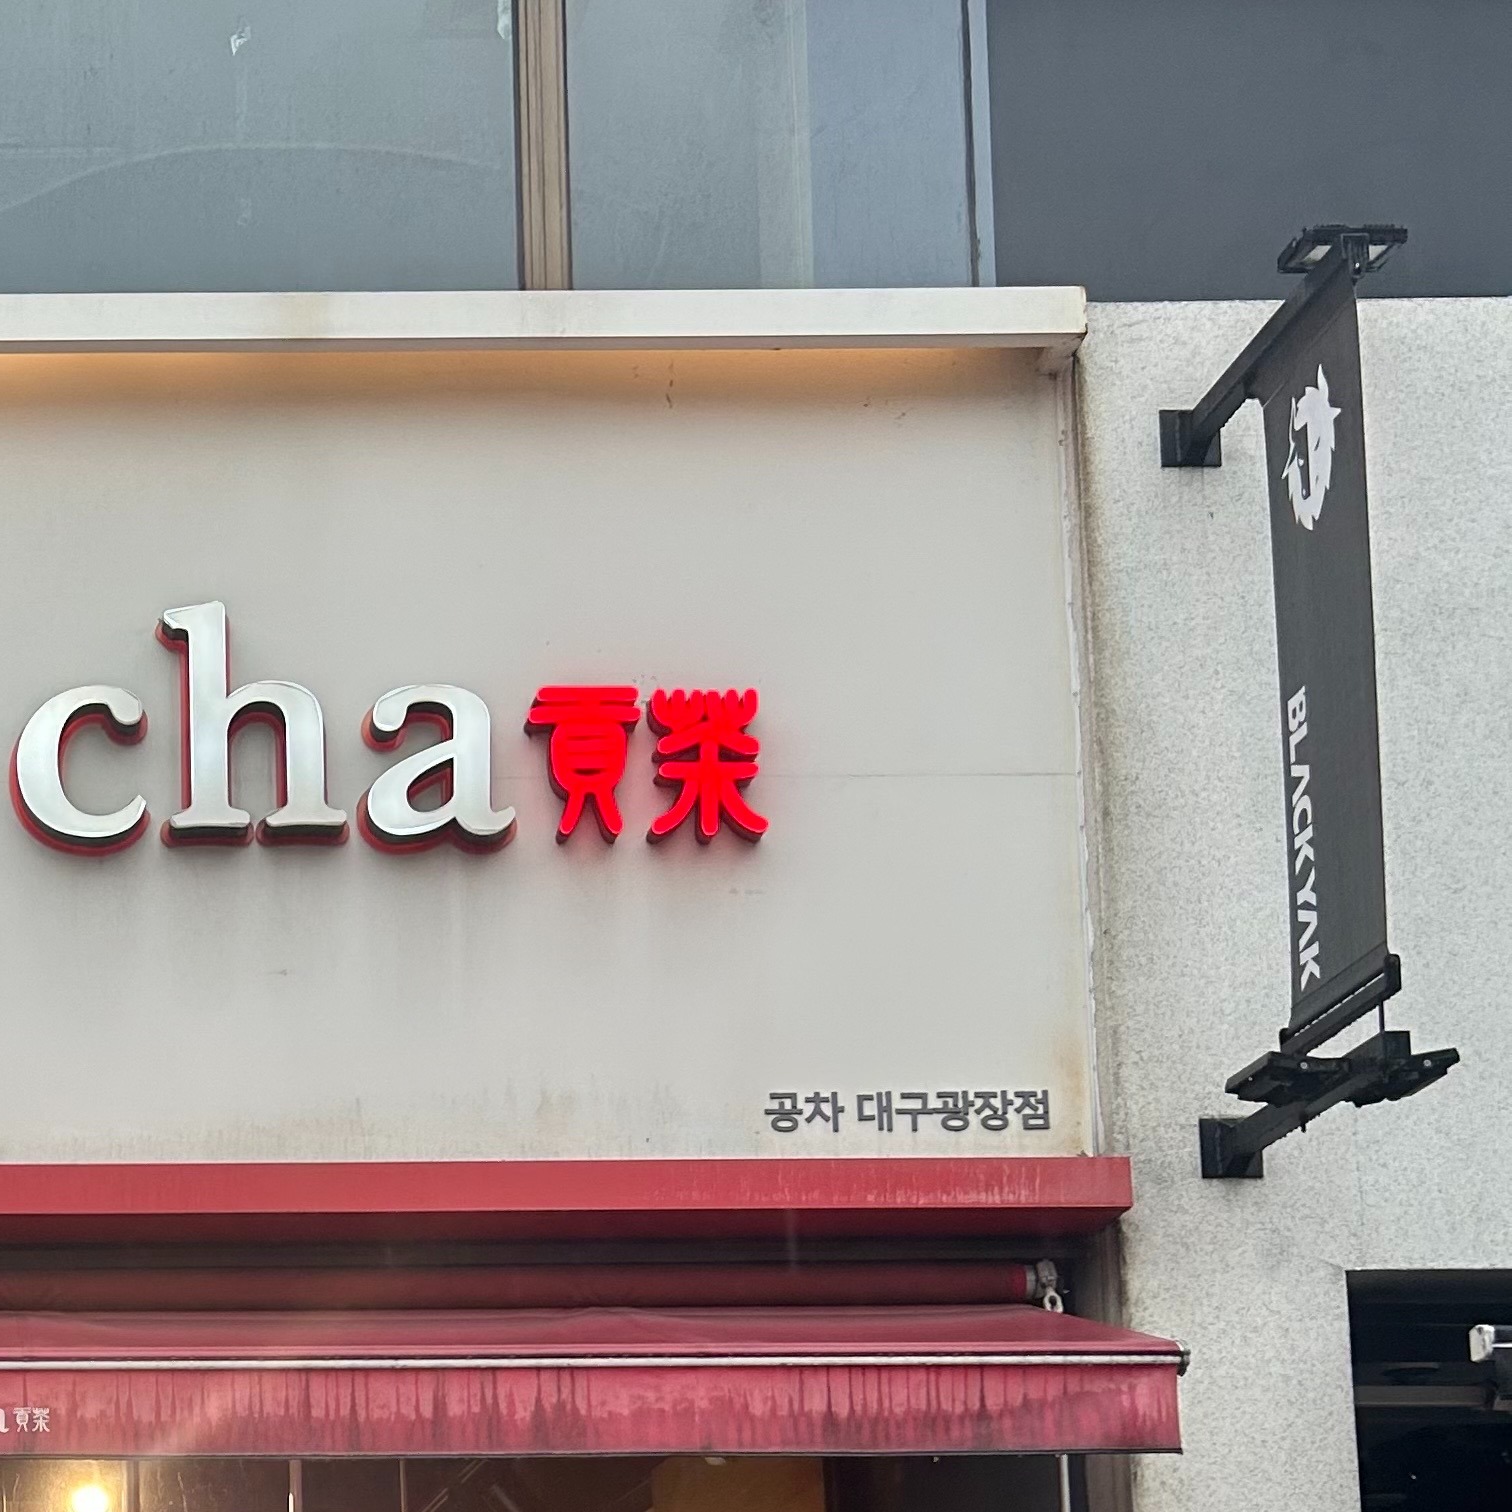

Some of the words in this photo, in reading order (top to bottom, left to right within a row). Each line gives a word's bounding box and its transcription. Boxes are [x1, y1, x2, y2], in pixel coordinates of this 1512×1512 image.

[9, 600, 518, 856] cha
[1287, 684, 1321, 992] BLACKYAK
[764, 1090, 845, 1133] 공차
[856, 1088, 1051, 1132] 대구광장점
